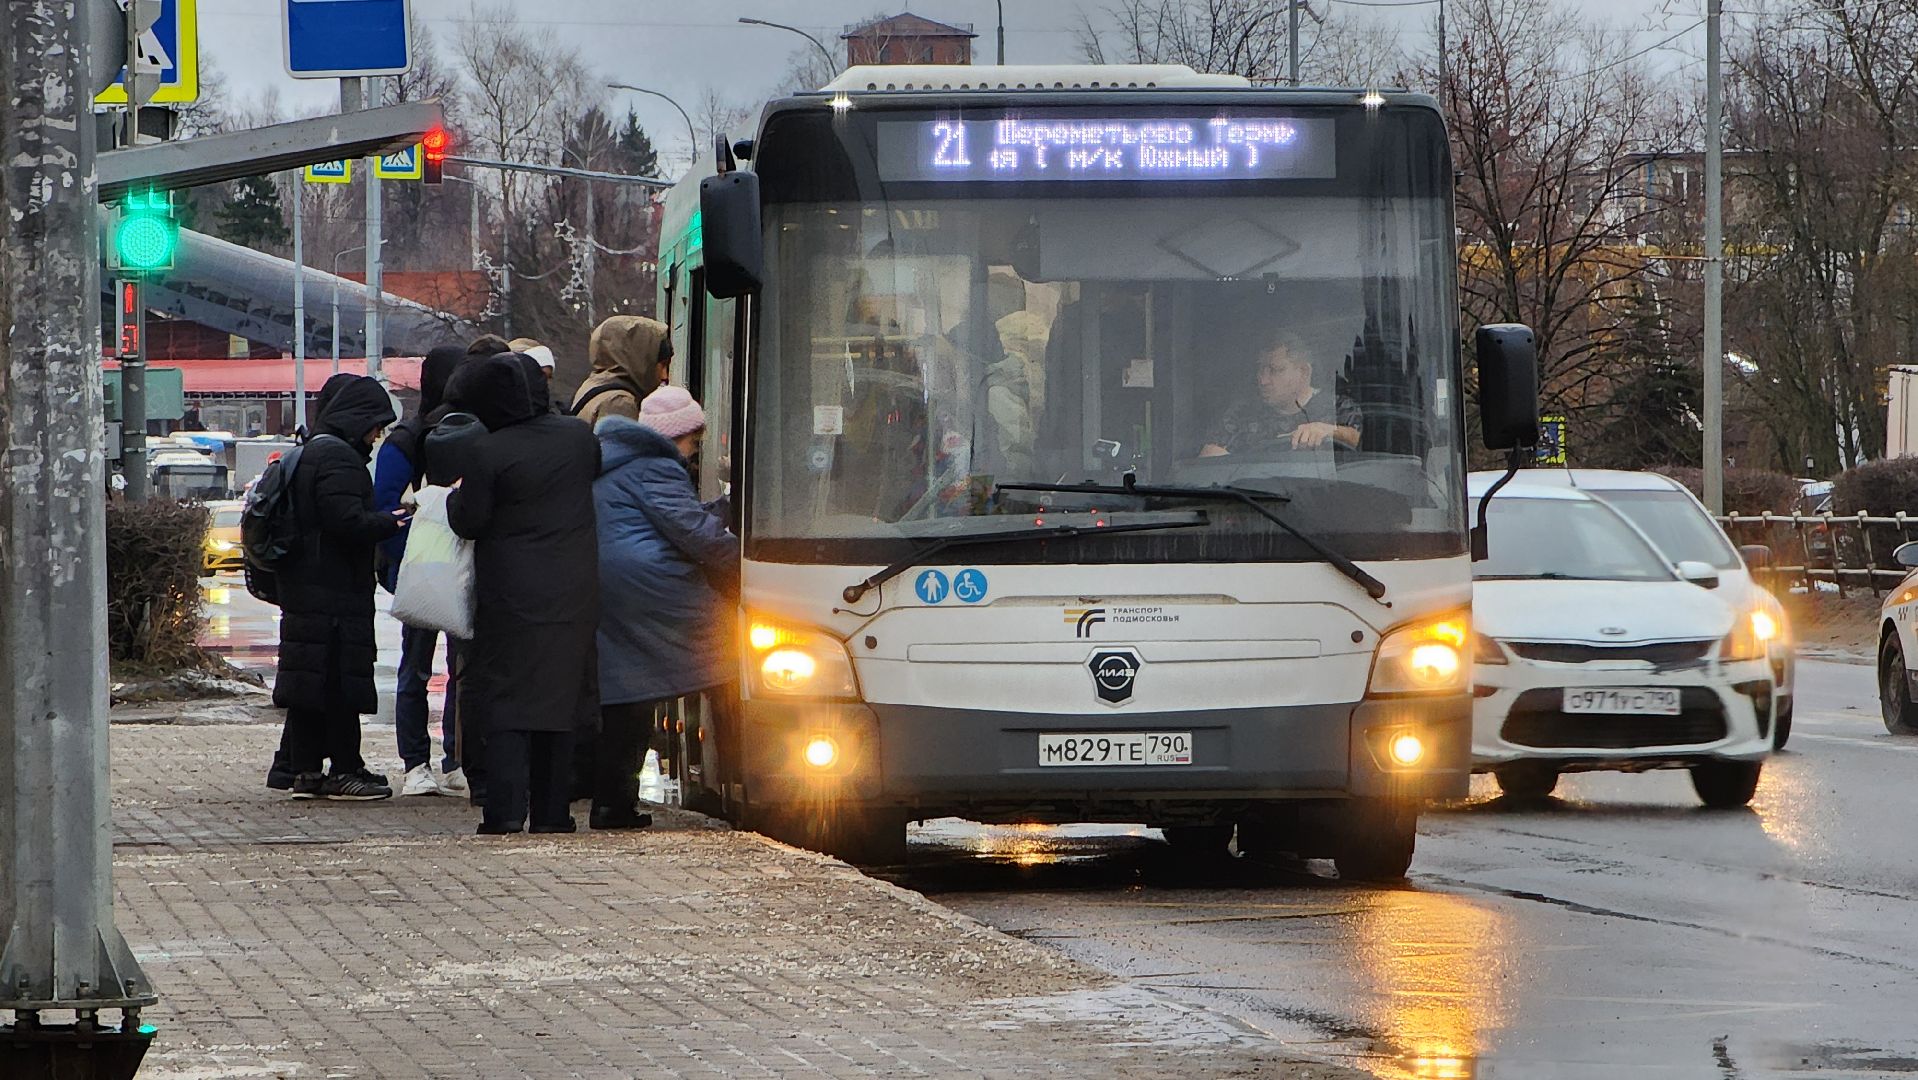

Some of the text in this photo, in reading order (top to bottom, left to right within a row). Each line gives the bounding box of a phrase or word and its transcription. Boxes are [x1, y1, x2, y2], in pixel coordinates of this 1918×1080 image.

[934, 122, 972, 165] 21
[1138, 145, 1229, 168] Южный
[1113, 607, 1163, 615] ТРАНСПОРТ
[1113, 615, 1180, 623] ПОДМОСКОВЬЯ
[1148, 735, 1185, 754] 790
[1157, 754, 1175, 762] RUS
